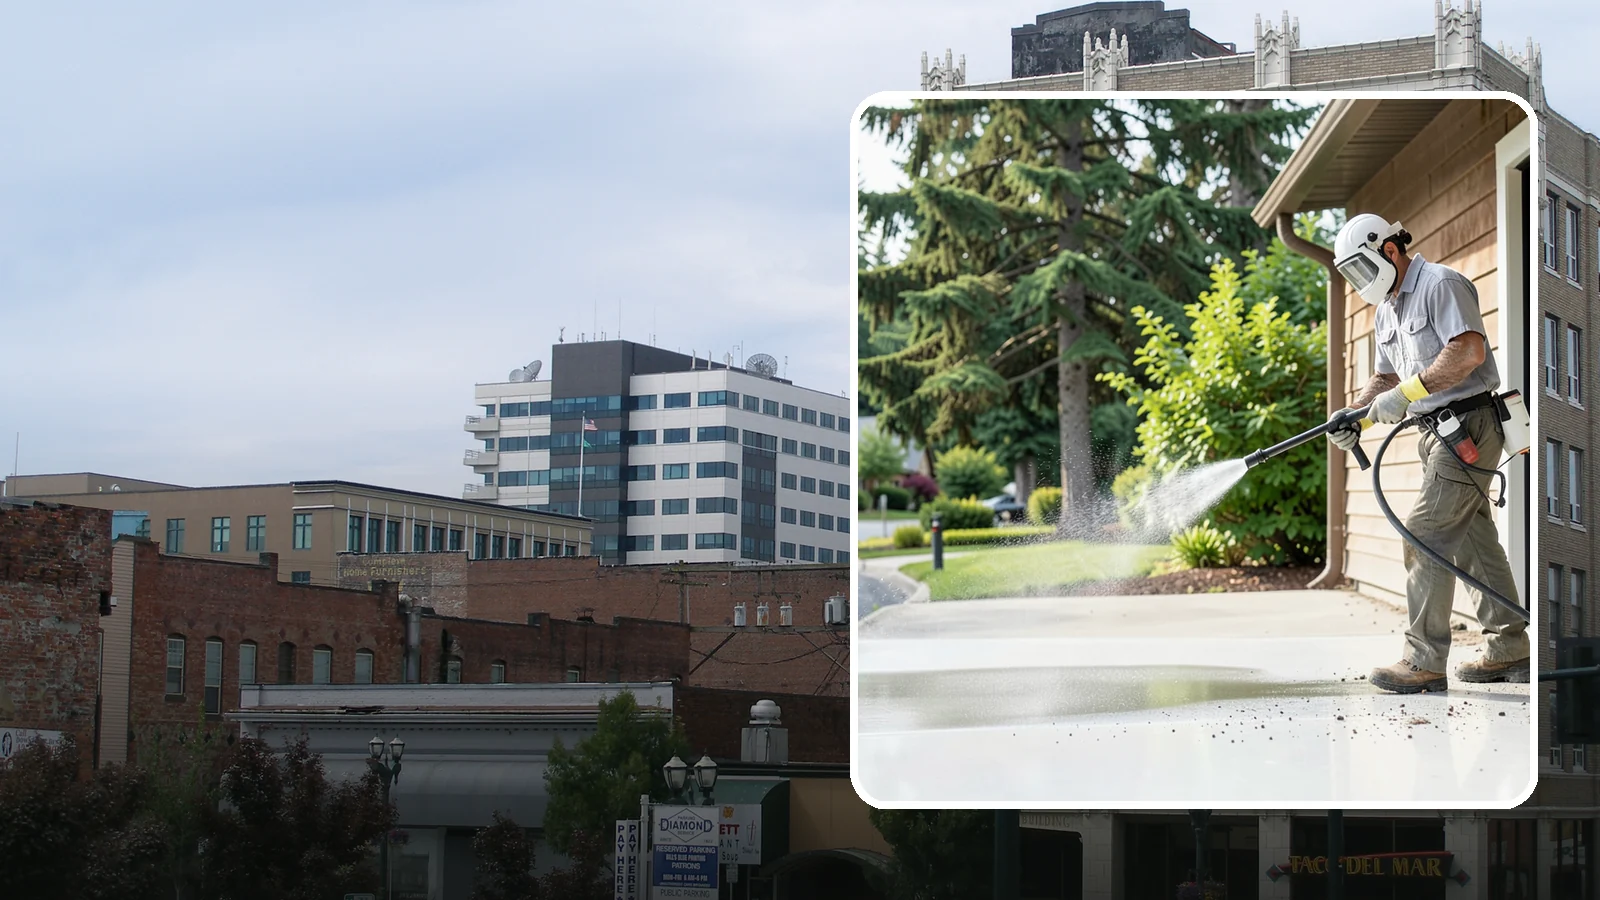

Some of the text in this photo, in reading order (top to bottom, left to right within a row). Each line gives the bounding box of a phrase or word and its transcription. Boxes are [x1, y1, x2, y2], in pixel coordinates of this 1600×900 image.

[660, 818, 713, 833] DIAMOND
[1022, 816, 1070, 828] BUILDING
[722, 852, 739, 861] Soup
[671, 862, 700, 870] PATRONS
[1346, 857, 1385, 875] DEL
[1392, 858, 1442, 877] MAR
[660, 889, 710, 898] PUBLIC PARKING
